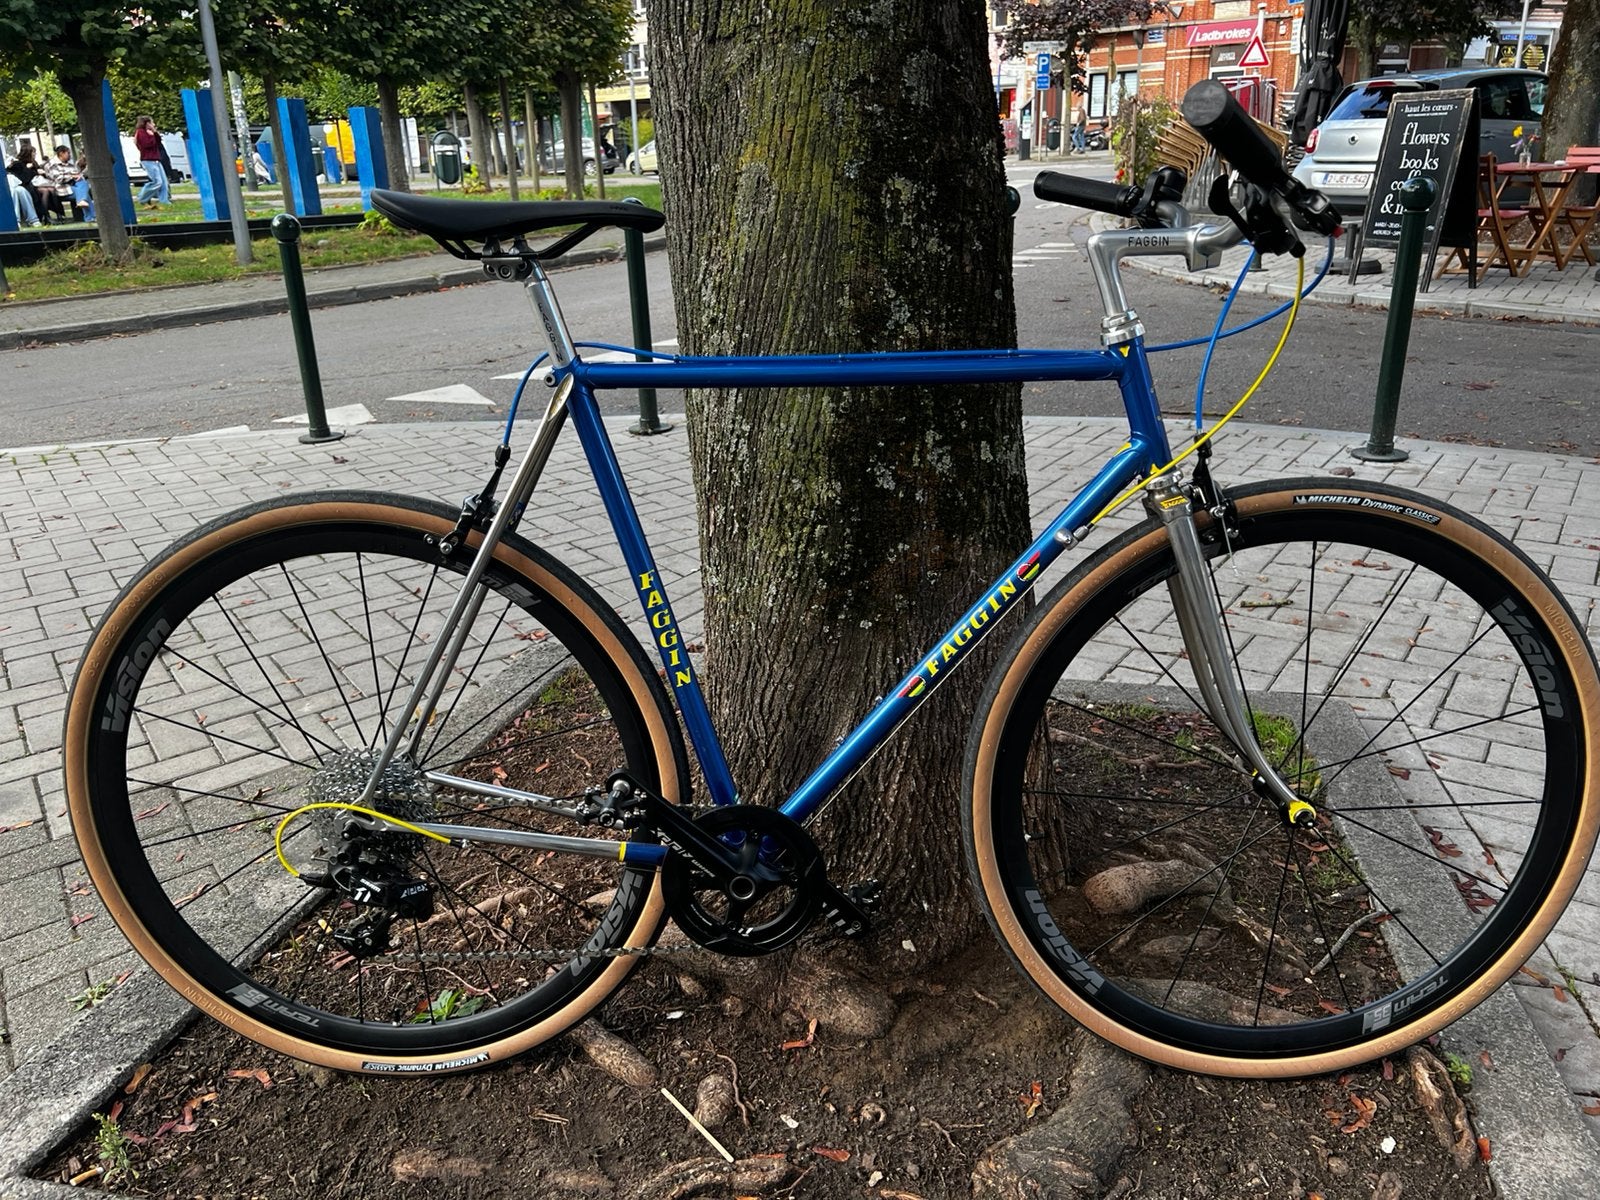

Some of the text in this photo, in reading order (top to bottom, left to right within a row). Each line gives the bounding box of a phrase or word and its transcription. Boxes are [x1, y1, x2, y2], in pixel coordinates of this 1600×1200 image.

[1195, 27, 1252, 42] Ladbrokes
[1039, 56, 1049, 71] P
[1421, 103, 1431, 112] les
[1400, 122, 1451, 145] flowers
[1399, 149, 1439, 169] books
[1380, 193, 1394, 214] &
[1128, 236, 1169, 247] FAGGIN
[537, 302, 563, 363] FAGGIN
[1307, 495, 1362, 505] MICHELIN
[1361, 498, 1403, 513] Dynamic
[639, 569, 692, 688] FAGGIN
[924, 577, 1017, 677] FAGGIN
[1393, 975, 1449, 1012] TEAM
[262, 1000, 320, 1028] TEAM
[435, 1056, 477, 1070] MICHELIN
